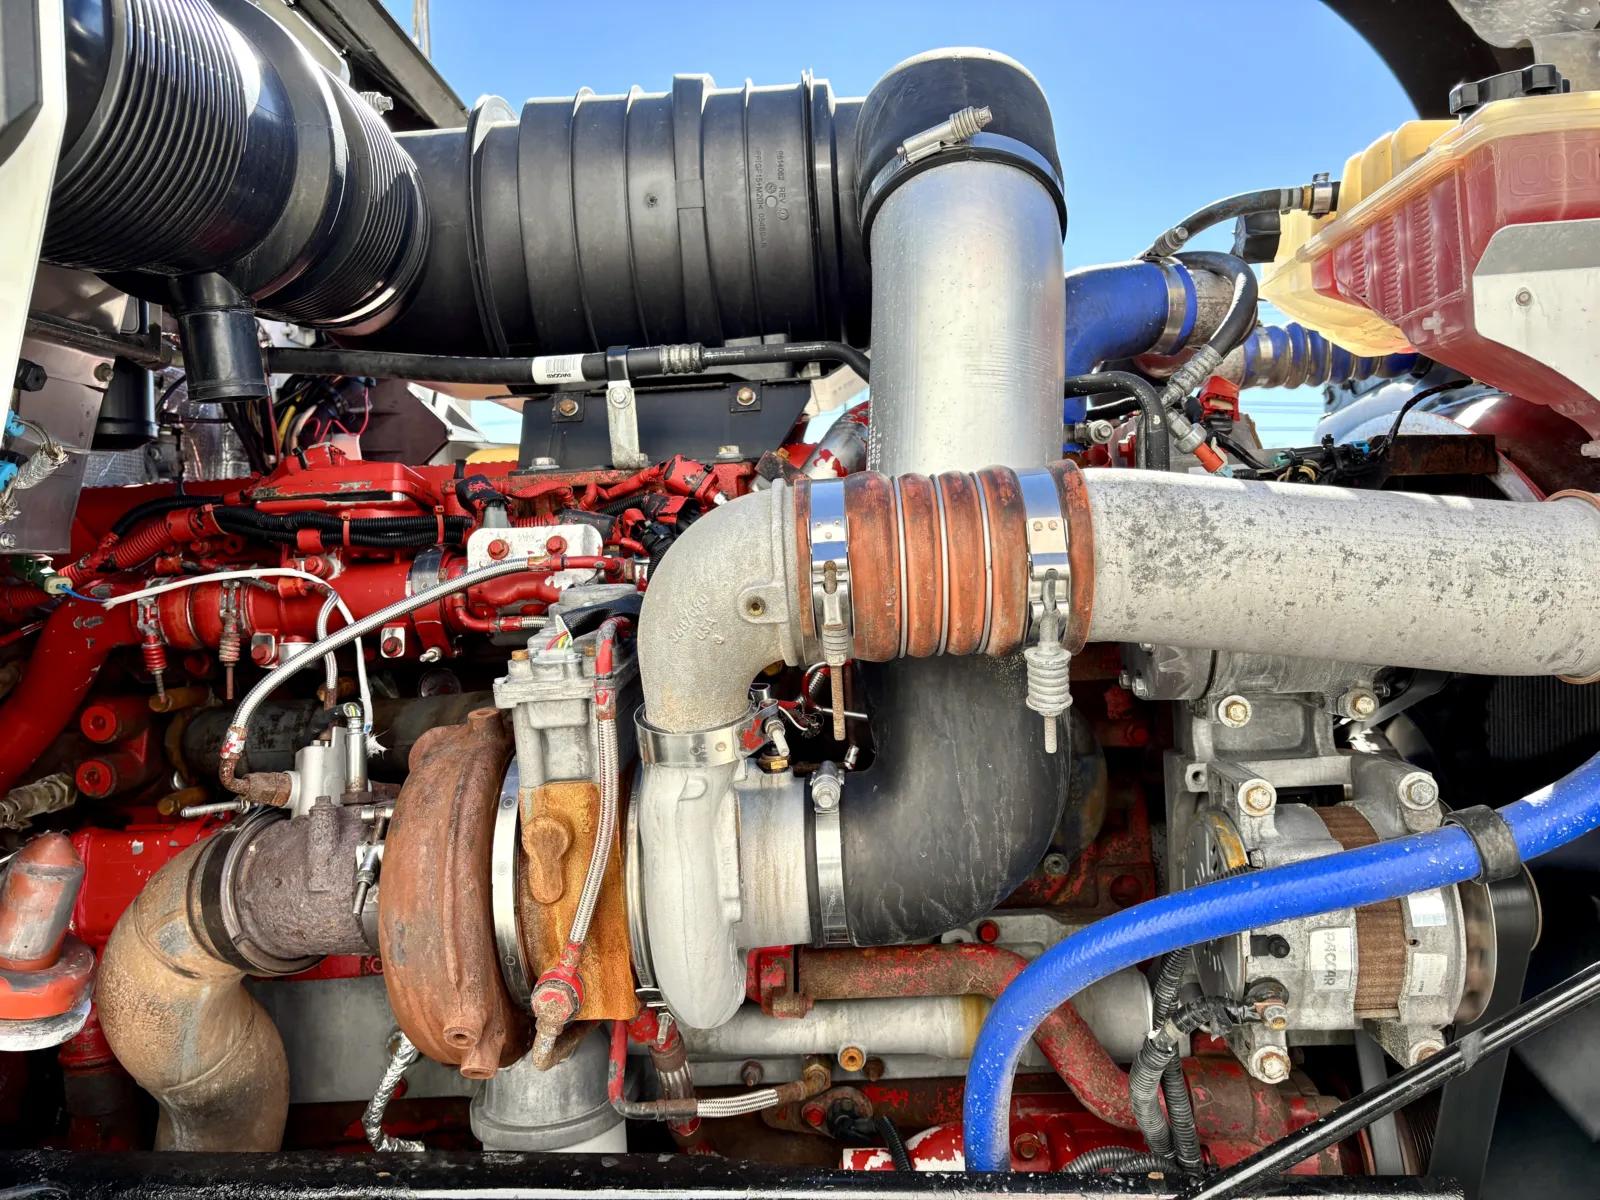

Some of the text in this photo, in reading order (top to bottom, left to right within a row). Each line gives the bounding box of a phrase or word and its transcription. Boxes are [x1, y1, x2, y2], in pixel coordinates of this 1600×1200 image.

[1519, 147, 1600, 185] COO
[779, 186, 787, 203] REV
[695, 617, 718, 641] USA
